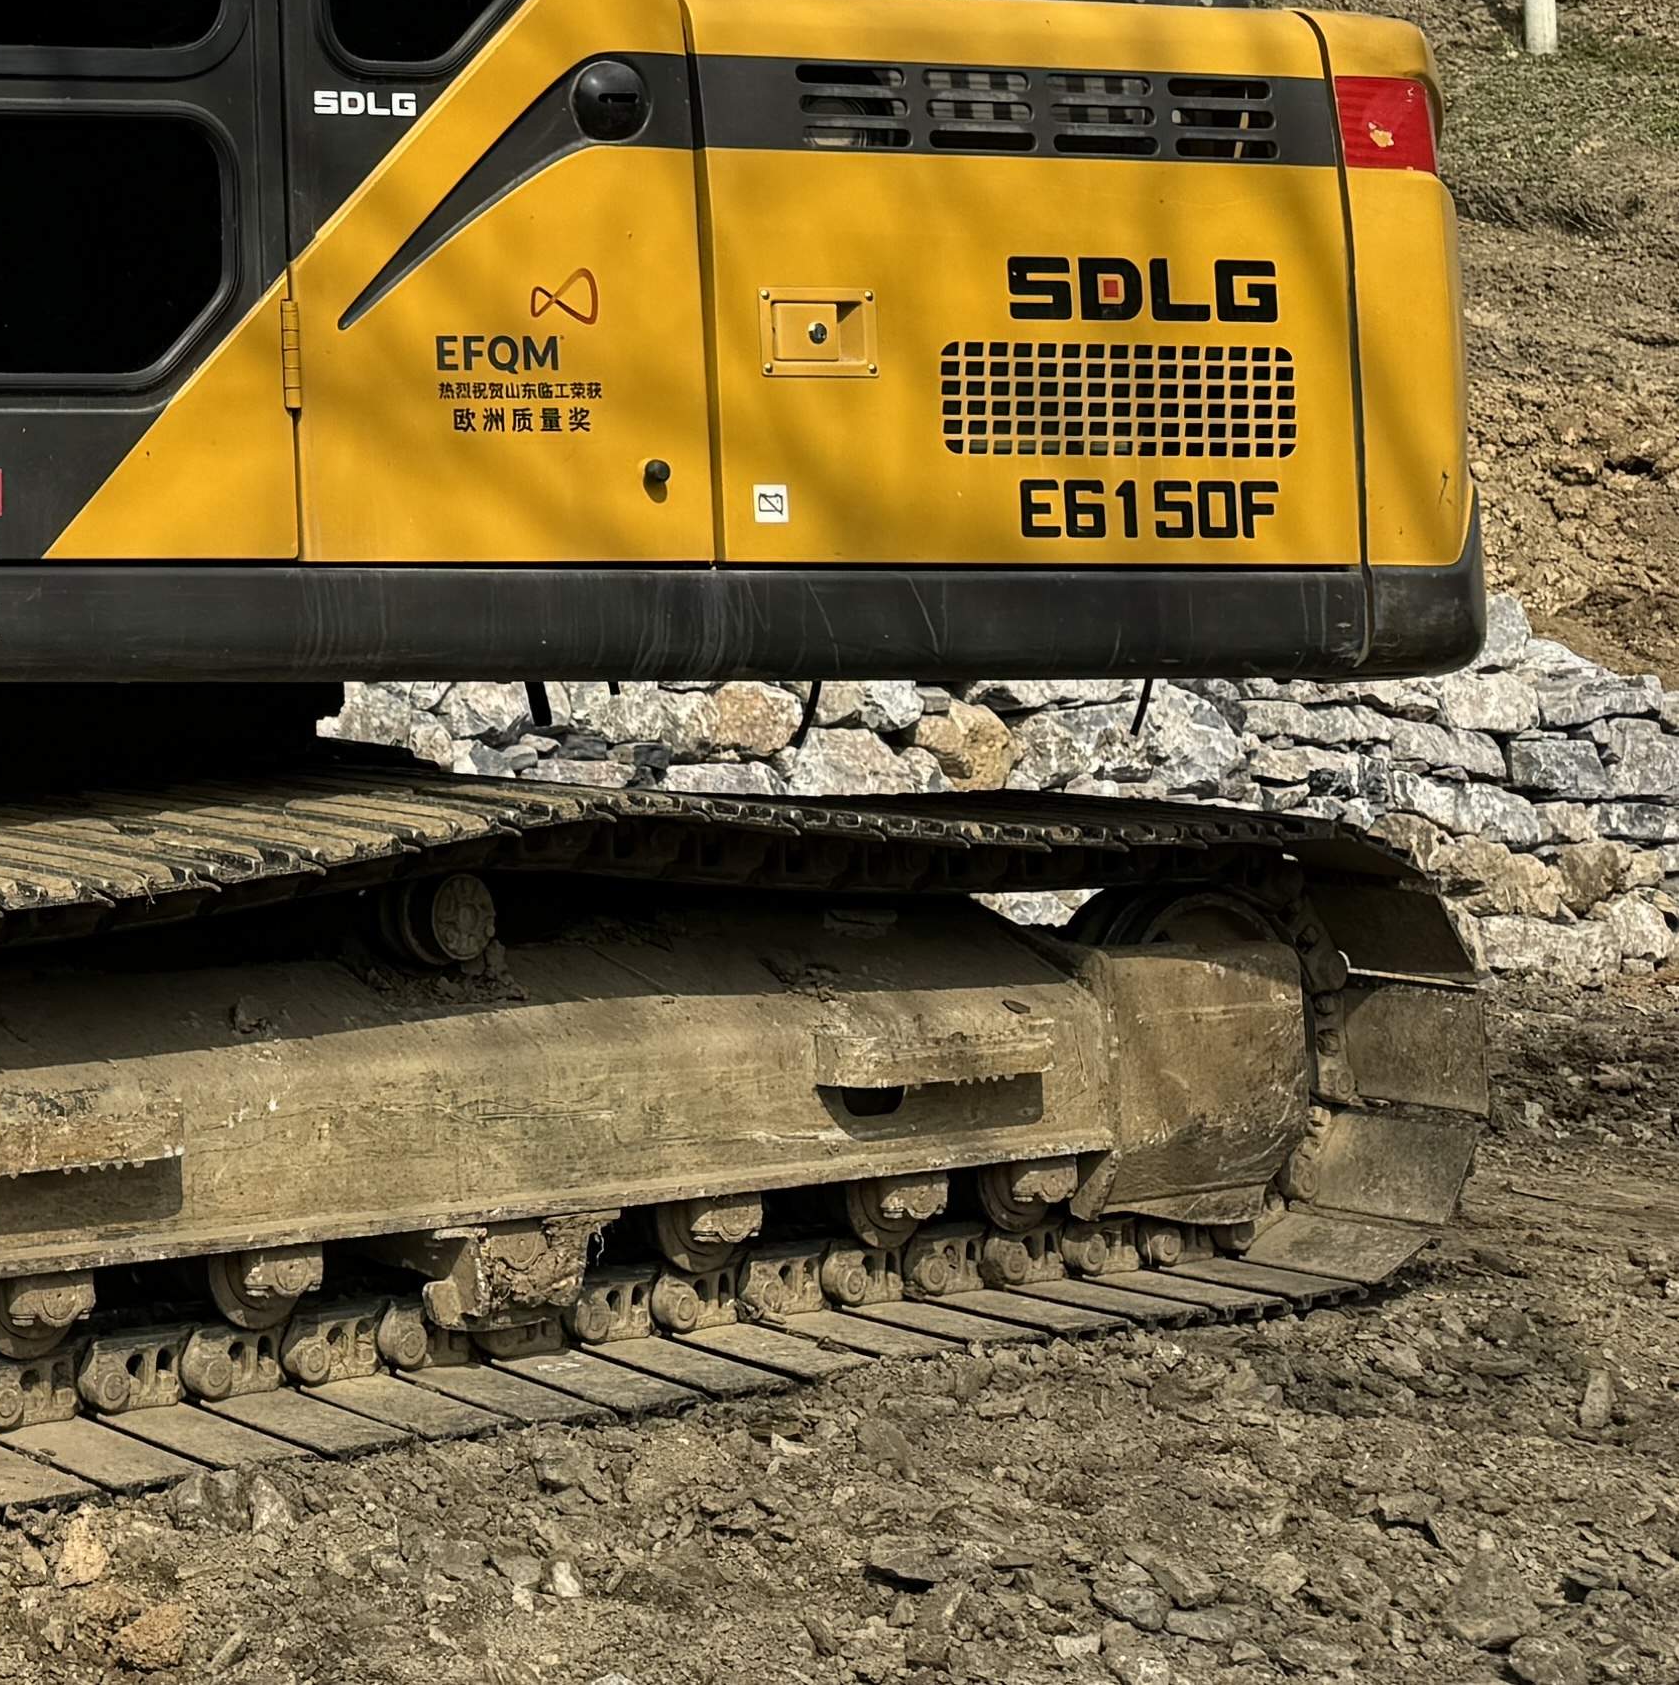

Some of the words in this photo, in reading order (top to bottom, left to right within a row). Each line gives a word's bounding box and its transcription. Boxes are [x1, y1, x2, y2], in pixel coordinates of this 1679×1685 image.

[313, 90, 417, 116] SDLG
[1007, 256, 1279, 322] SDLG
[435, 334, 560, 374] EFQM
[438, 381, 603, 400] 热烈祝贺山东临工荣获
[453, 406, 592, 432] 欧洲质量奖
[1019, 479, 1280, 539] E6150F
